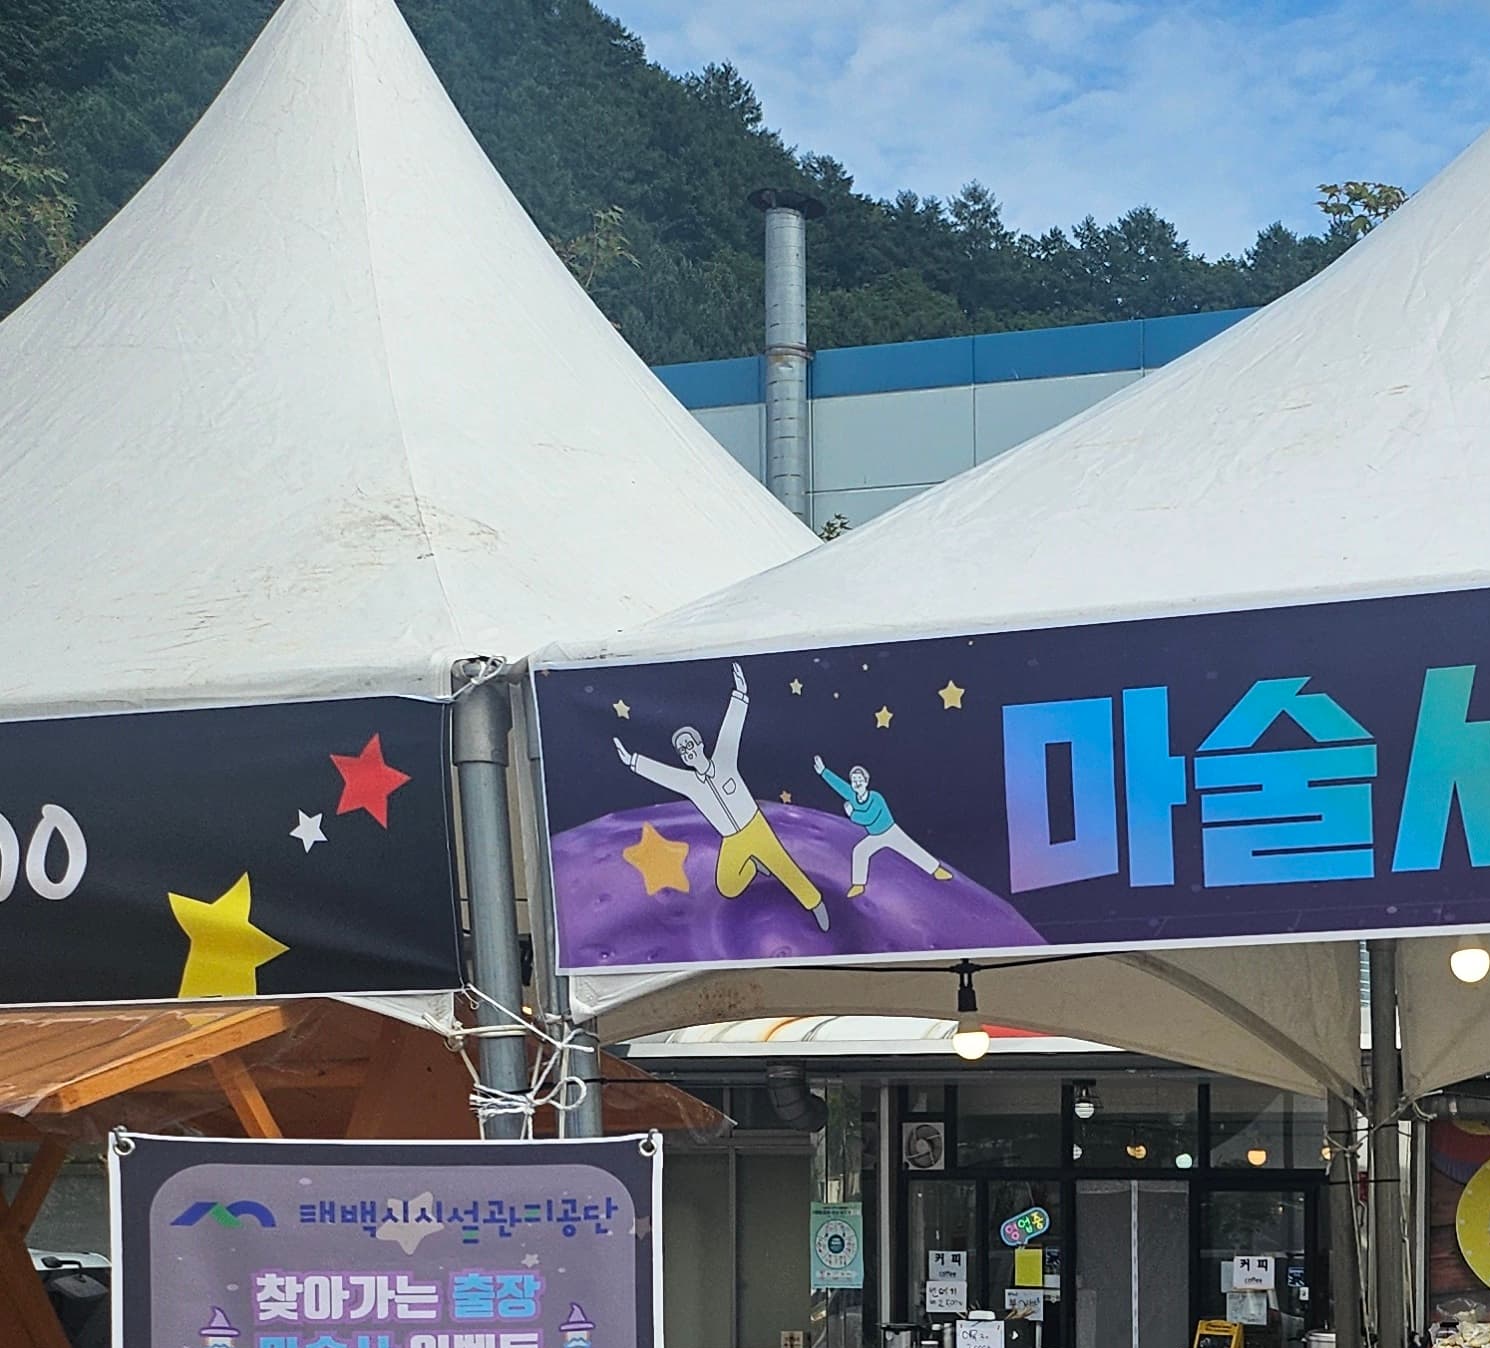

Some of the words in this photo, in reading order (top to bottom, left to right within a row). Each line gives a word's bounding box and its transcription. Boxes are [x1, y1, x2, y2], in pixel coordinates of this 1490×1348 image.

[299, 1197, 619, 1243] 태백시시설관리공단
[256, 1273, 439, 1320] 찾아가는
[452, 1274, 540, 1318] 출장
